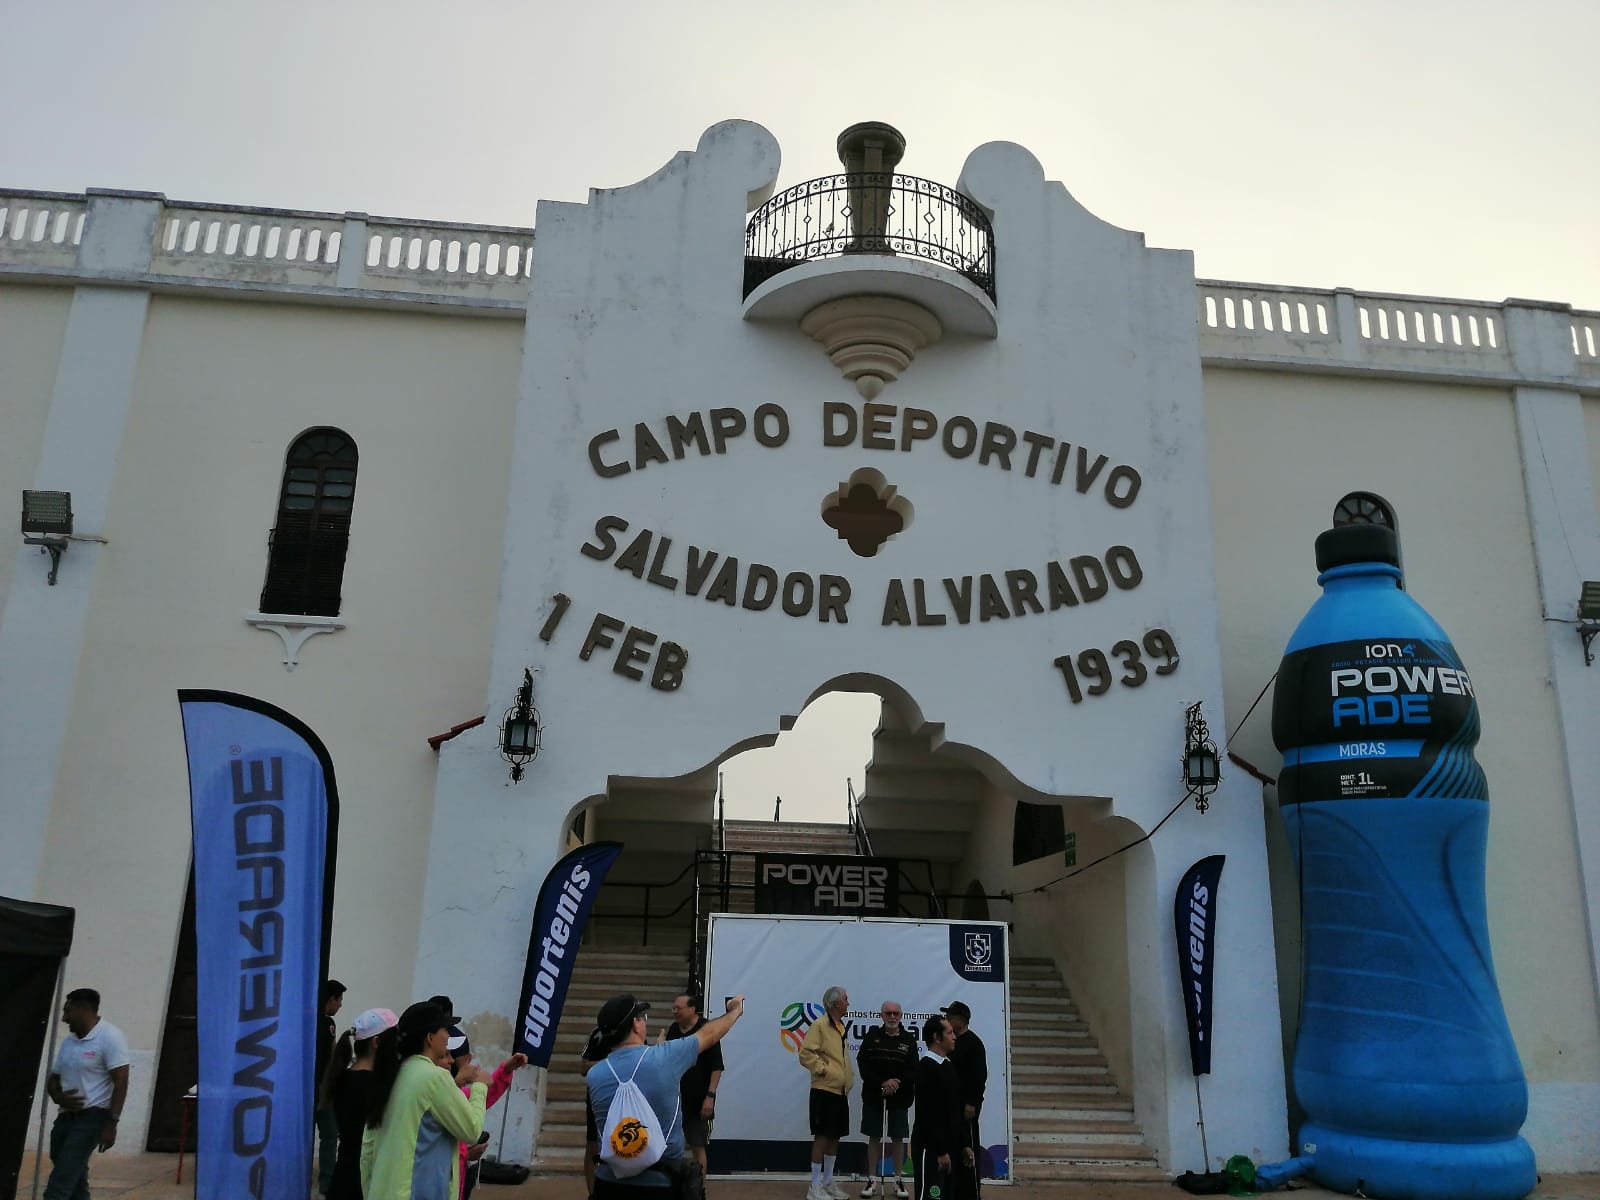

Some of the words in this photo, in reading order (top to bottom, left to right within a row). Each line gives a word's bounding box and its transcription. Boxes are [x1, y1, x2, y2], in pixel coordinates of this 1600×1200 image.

[588, 402, 790, 478] CAMPO
[823, 401, 1142, 509] DEPORTIVO
[580, 515, 852, 624] SALVADOR
[882, 544, 1143, 626] ALVARADO
[539, 592, 572, 642] 1
[579, 612, 689, 692] FEB
[1053, 628, 1180, 704] 1939
[1331, 667, 1475, 698] POWER
[1332, 694, 1432, 728] ADE
[1339, 742, 1387, 757] MORAS
[763, 863, 888, 886] POWER
[814, 885, 885, 908] ADE
